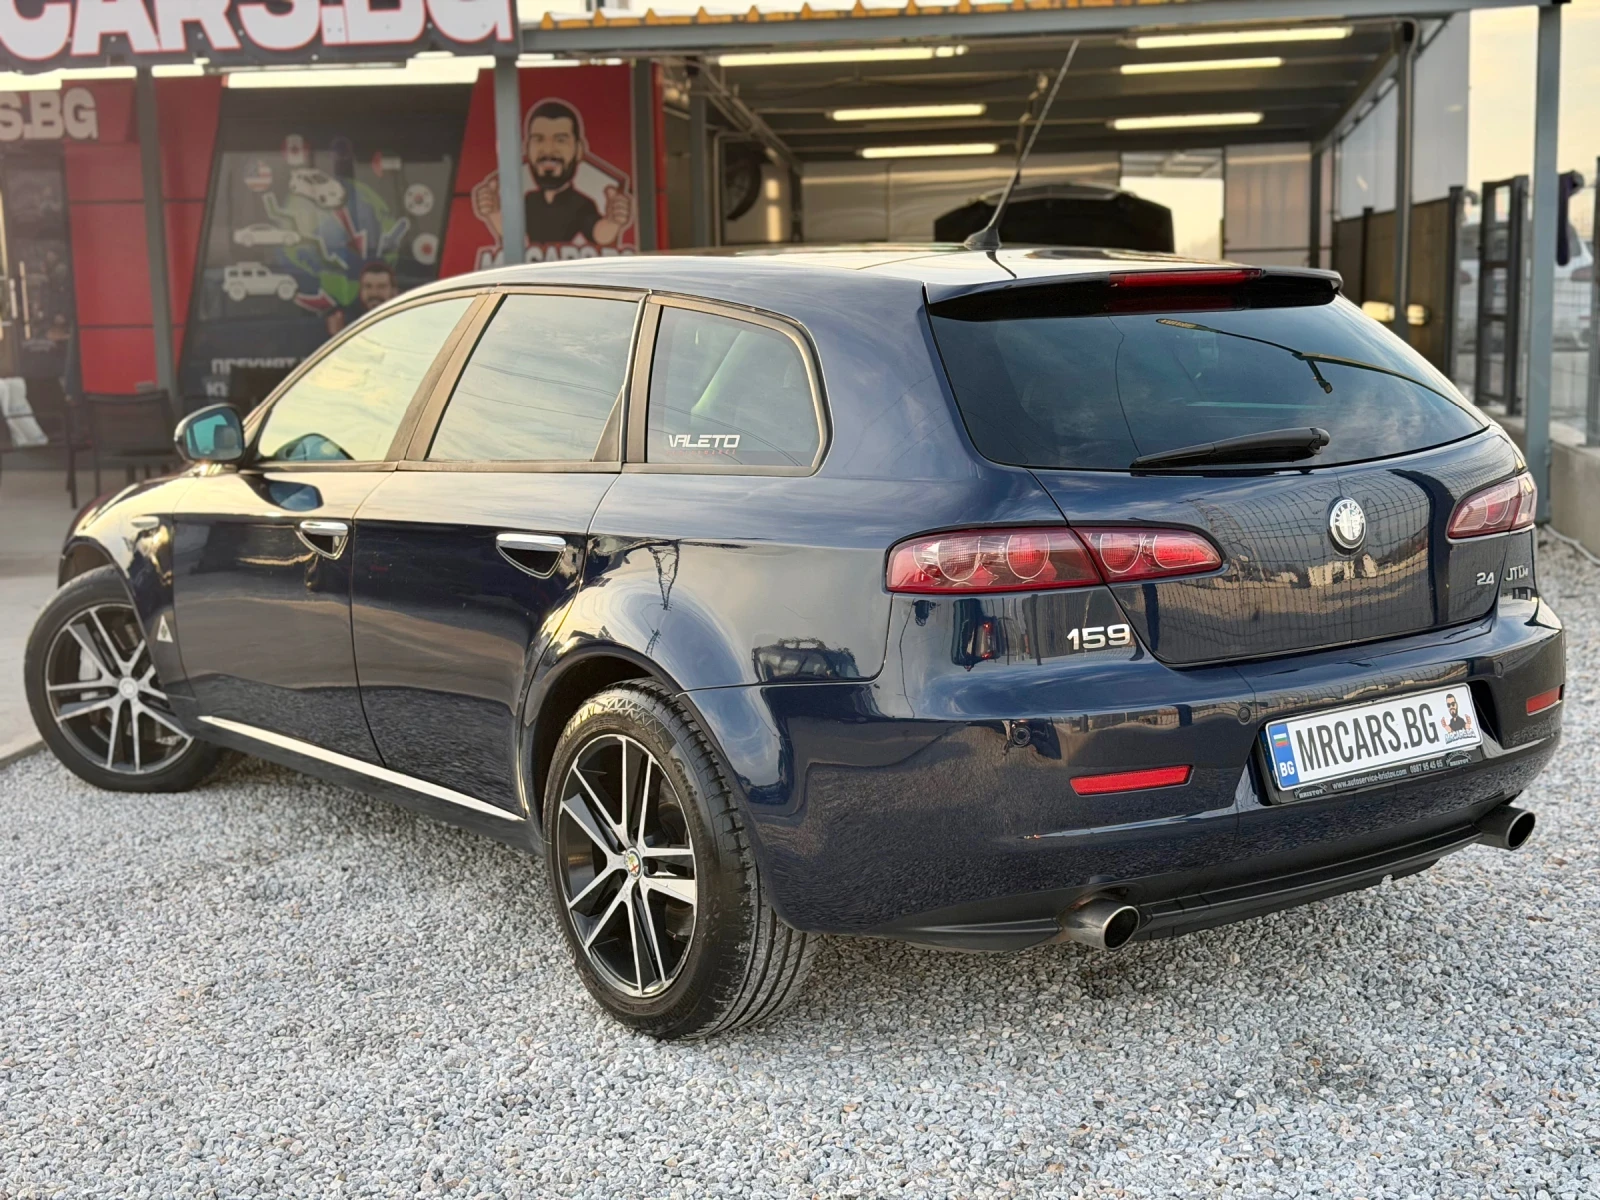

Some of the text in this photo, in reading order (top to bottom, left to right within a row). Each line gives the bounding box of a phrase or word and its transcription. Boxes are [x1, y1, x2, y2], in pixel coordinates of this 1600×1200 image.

[1066, 623, 1131, 650] 159
[1296, 703, 1440, 772] MRCARS.BG
[1279, 761, 1295, 777] BG
[1332, 768, 1407, 790] www.autoservice-hristov.com
